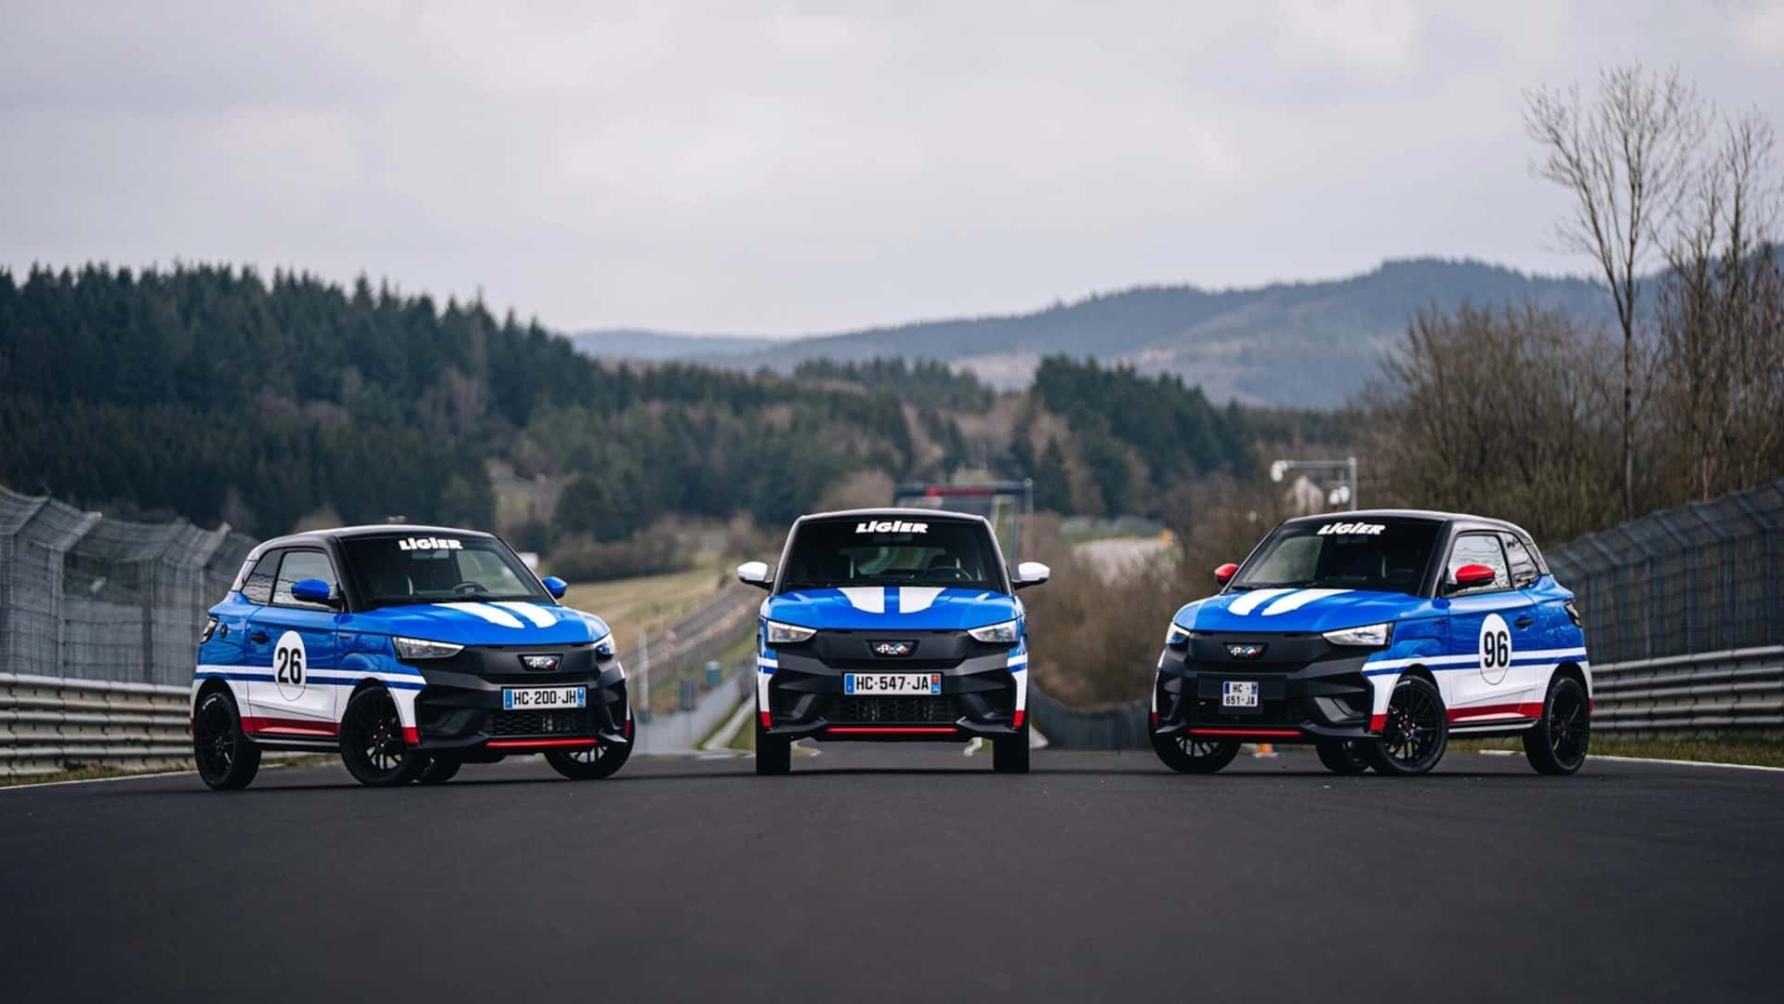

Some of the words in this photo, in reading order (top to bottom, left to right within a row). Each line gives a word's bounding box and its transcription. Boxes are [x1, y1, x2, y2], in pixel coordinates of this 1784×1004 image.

[855, 520, 929, 534] LIGIER
[1317, 521, 1386, 535] LIGIER
[398, 537, 464, 551] LIGIER
[1484, 630, 1508, 668] 96
[277, 646, 302, 685] 26
[856, 676, 929, 690] HC-547-JA
[513, 690, 577, 705] HC-200-JH
